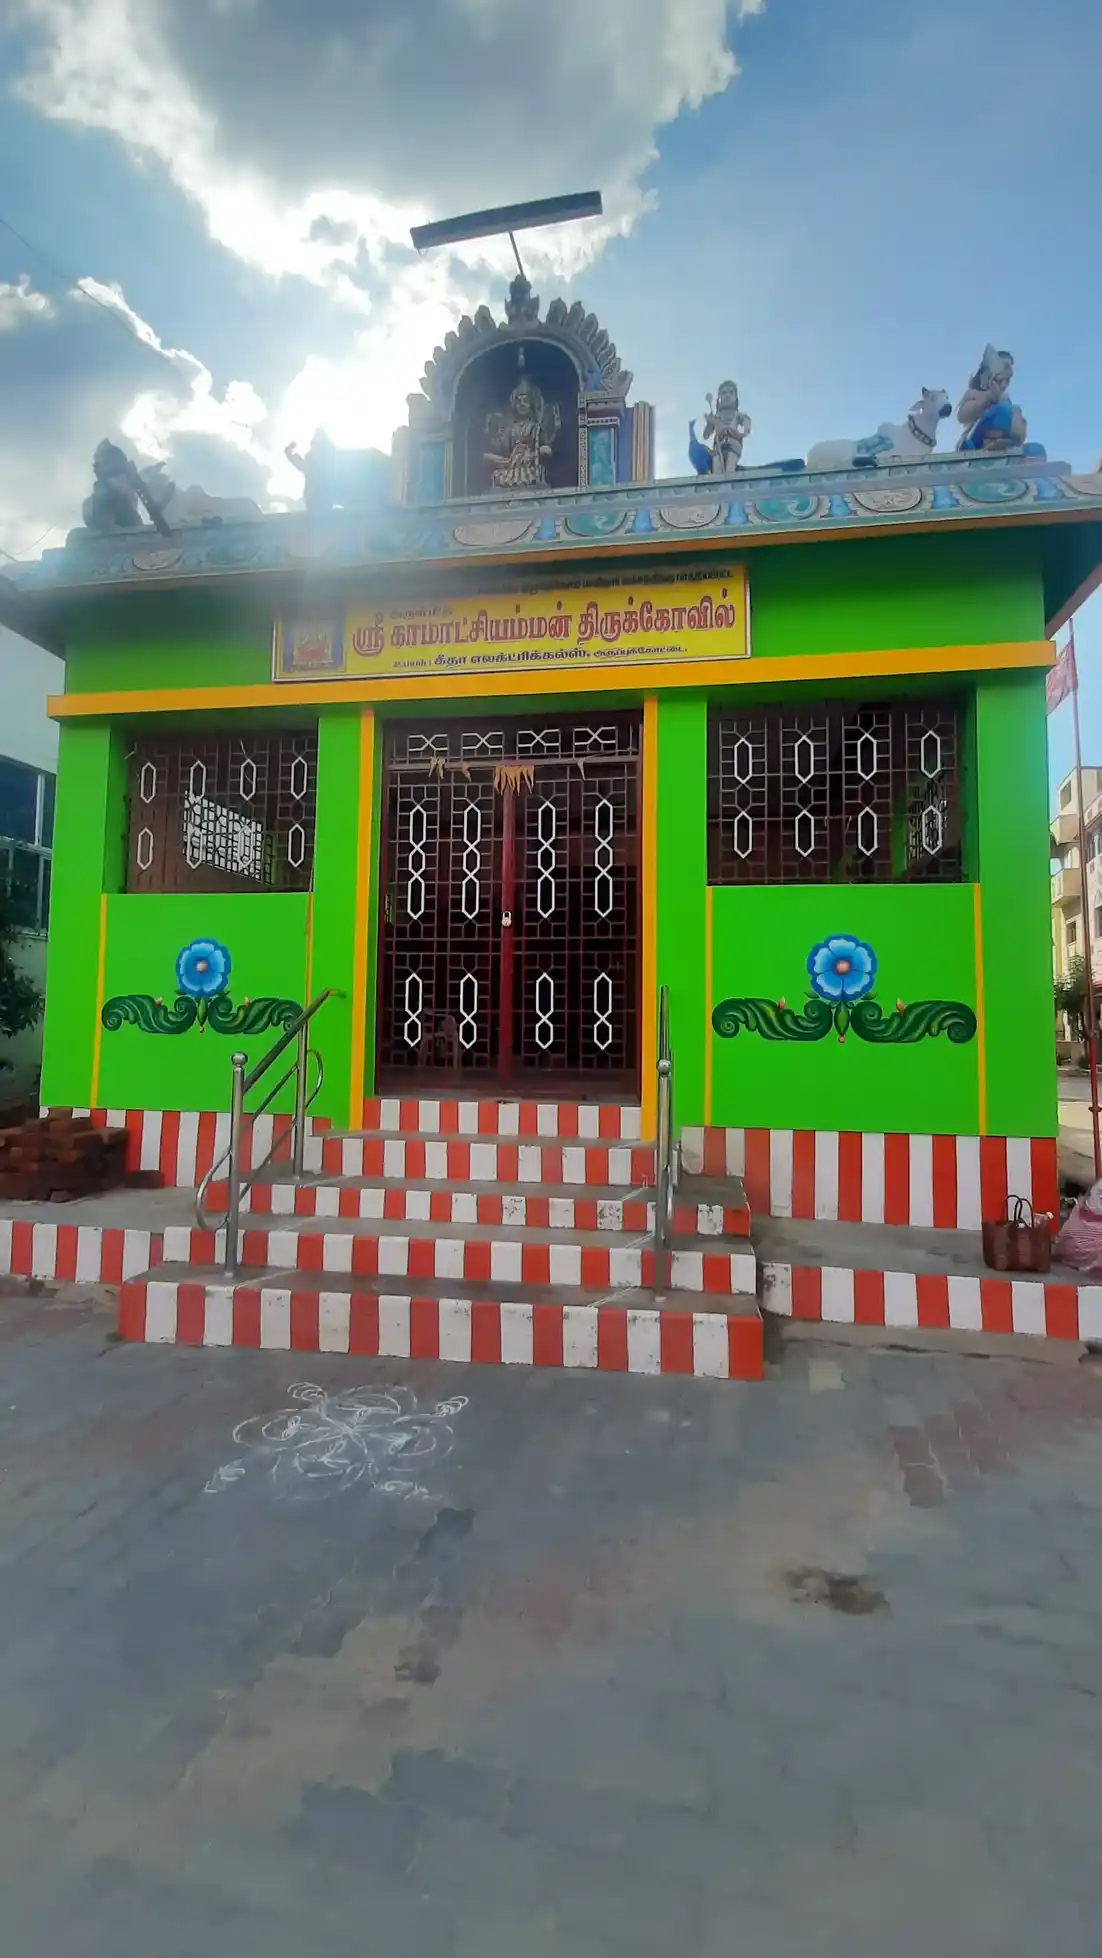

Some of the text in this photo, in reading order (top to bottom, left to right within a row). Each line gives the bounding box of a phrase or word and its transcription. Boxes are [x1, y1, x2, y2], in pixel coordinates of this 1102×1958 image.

[352, 587, 736, 657] ஸ்ரீ காமாட்சியம்மன் திருக்கோவில்
[434, 653, 467, 667] கீதா
